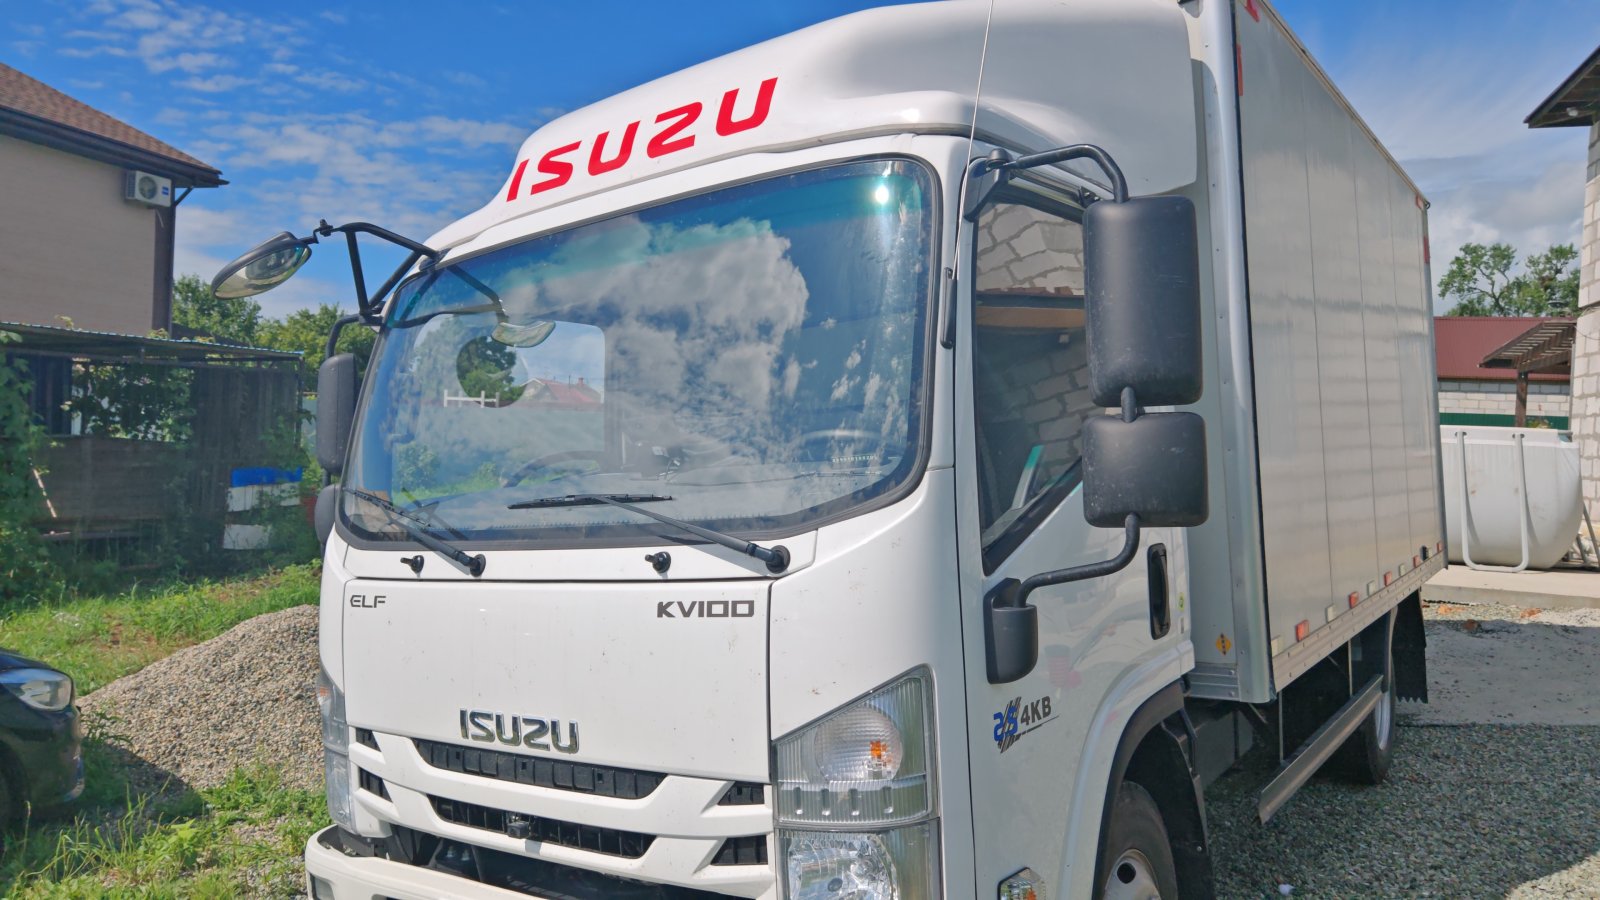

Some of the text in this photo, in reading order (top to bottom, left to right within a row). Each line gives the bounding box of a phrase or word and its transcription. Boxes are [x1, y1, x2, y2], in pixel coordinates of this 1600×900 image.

[506, 77, 779, 203] ISUZU
[350, 594, 387, 608] ELF
[656, 600, 755, 618] KV100
[1020, 696, 1051, 726] 4KB
[459, 707, 579, 754] ISUZU
